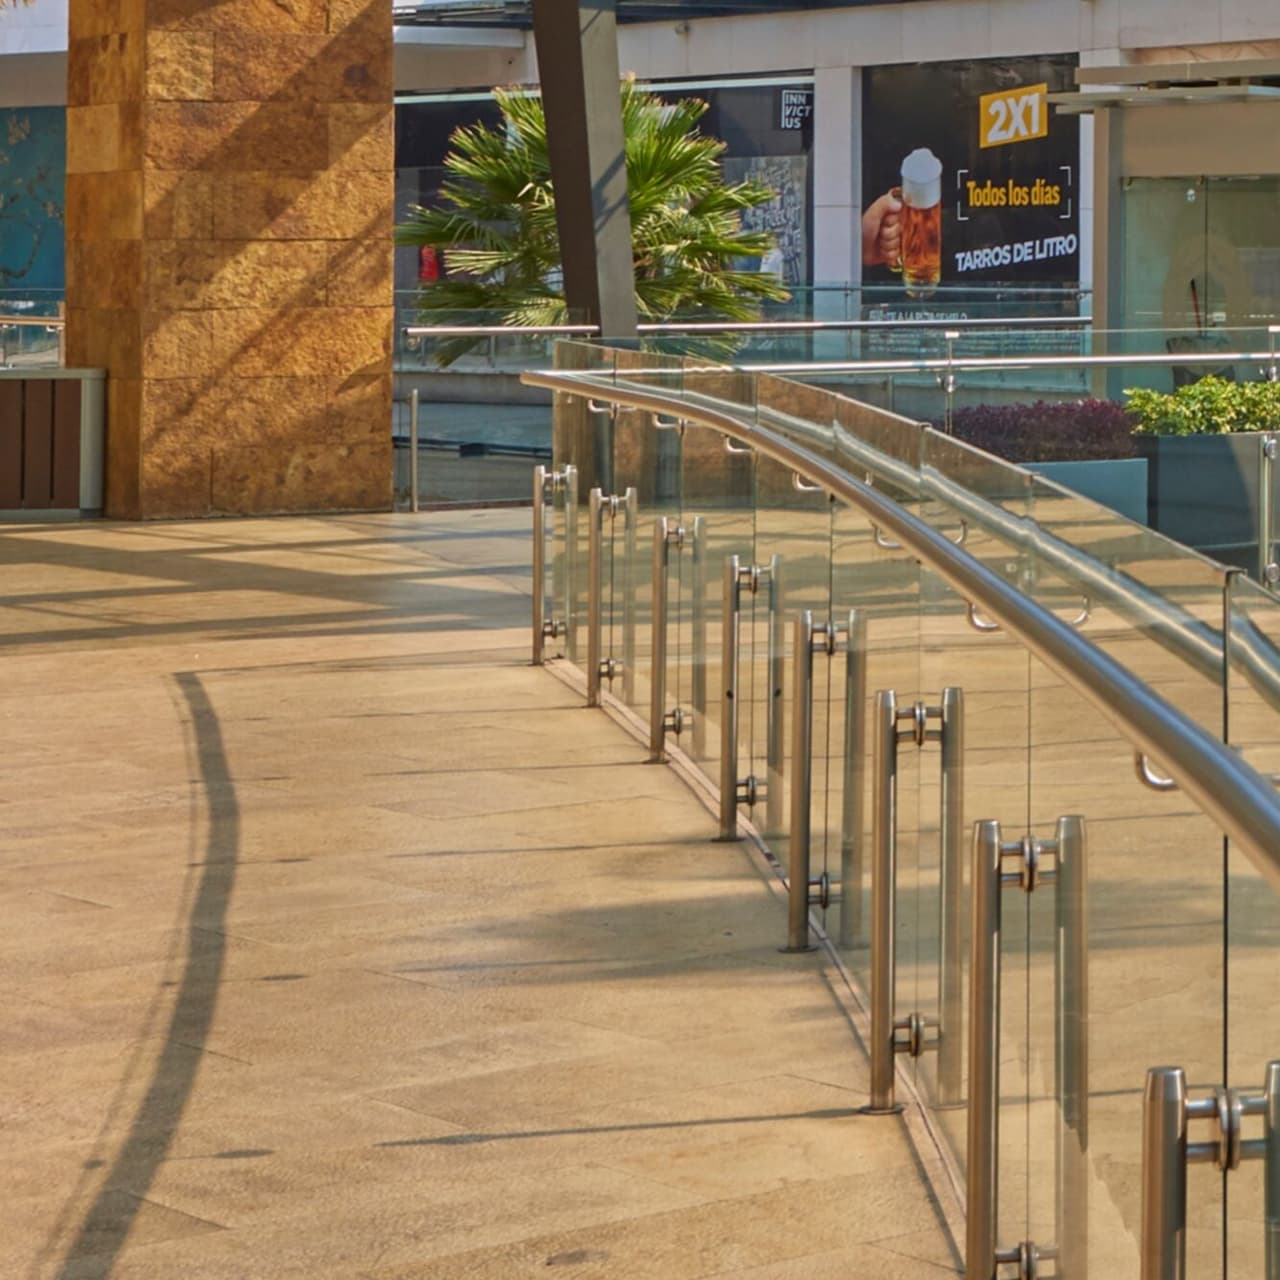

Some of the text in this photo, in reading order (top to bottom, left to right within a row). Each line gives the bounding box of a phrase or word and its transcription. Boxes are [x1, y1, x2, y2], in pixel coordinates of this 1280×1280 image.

[785, 117, 802, 129] US
[987, 92, 1041, 143] 2X1
[966, 178, 1060, 207] Todos los días
[955, 234, 1078, 272] TARROS DE LITRO
